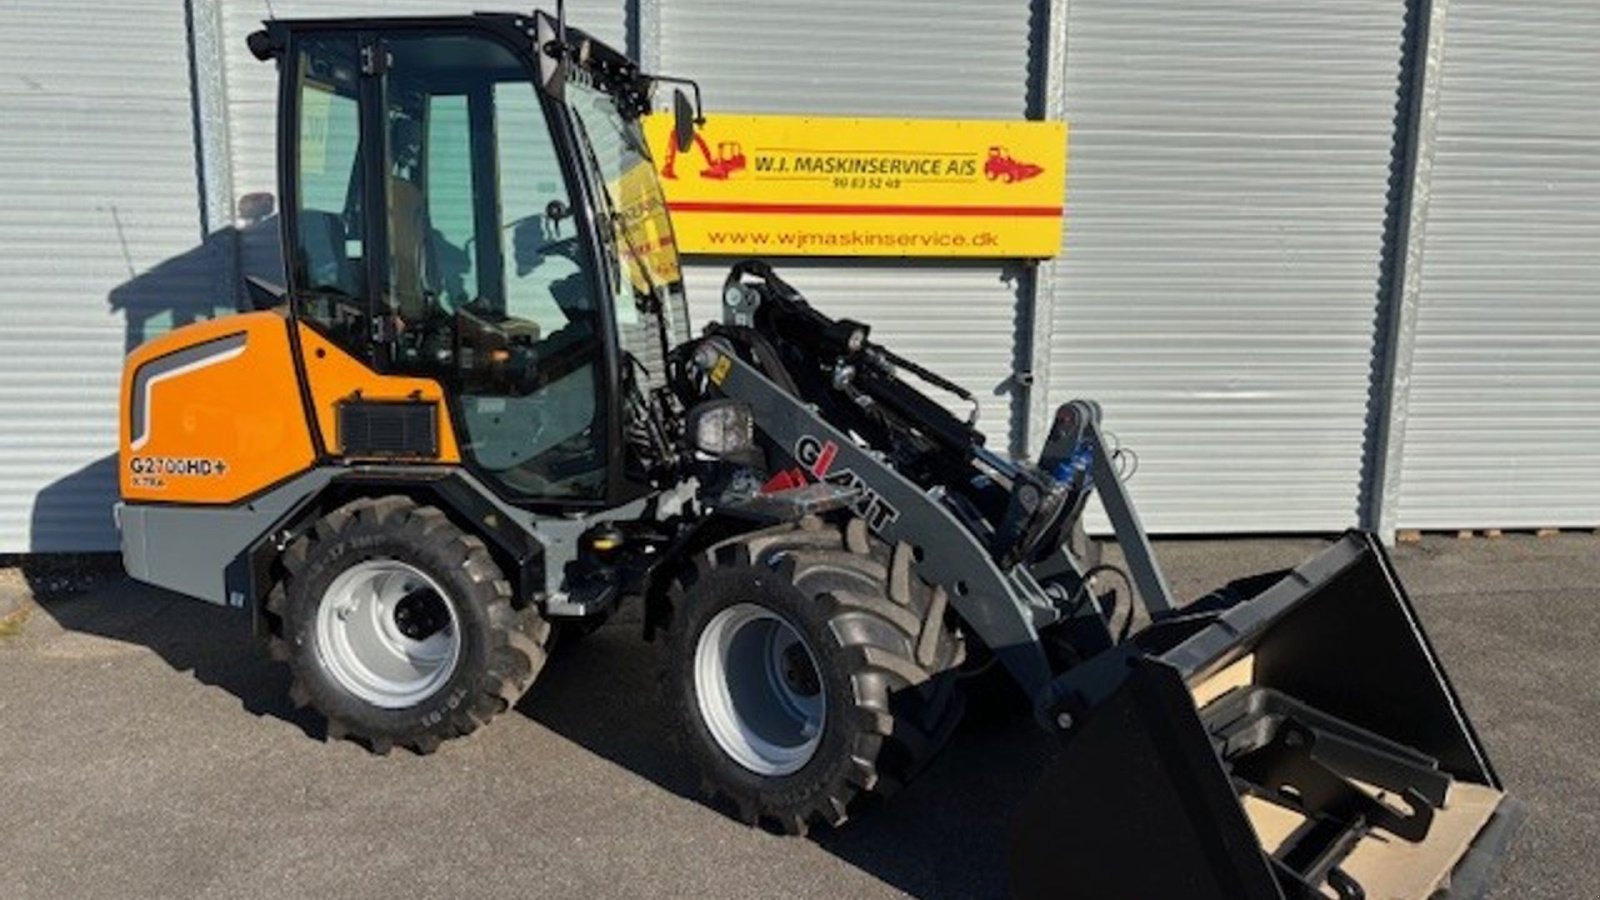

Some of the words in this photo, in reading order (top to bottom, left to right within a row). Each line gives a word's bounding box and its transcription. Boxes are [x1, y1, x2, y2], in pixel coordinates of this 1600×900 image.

[794, 157, 941, 175] MASKINSERVICE
[945, 159, 977, 176] A/S
[707, 229, 999, 248] www.wjmaskinservice.dk
